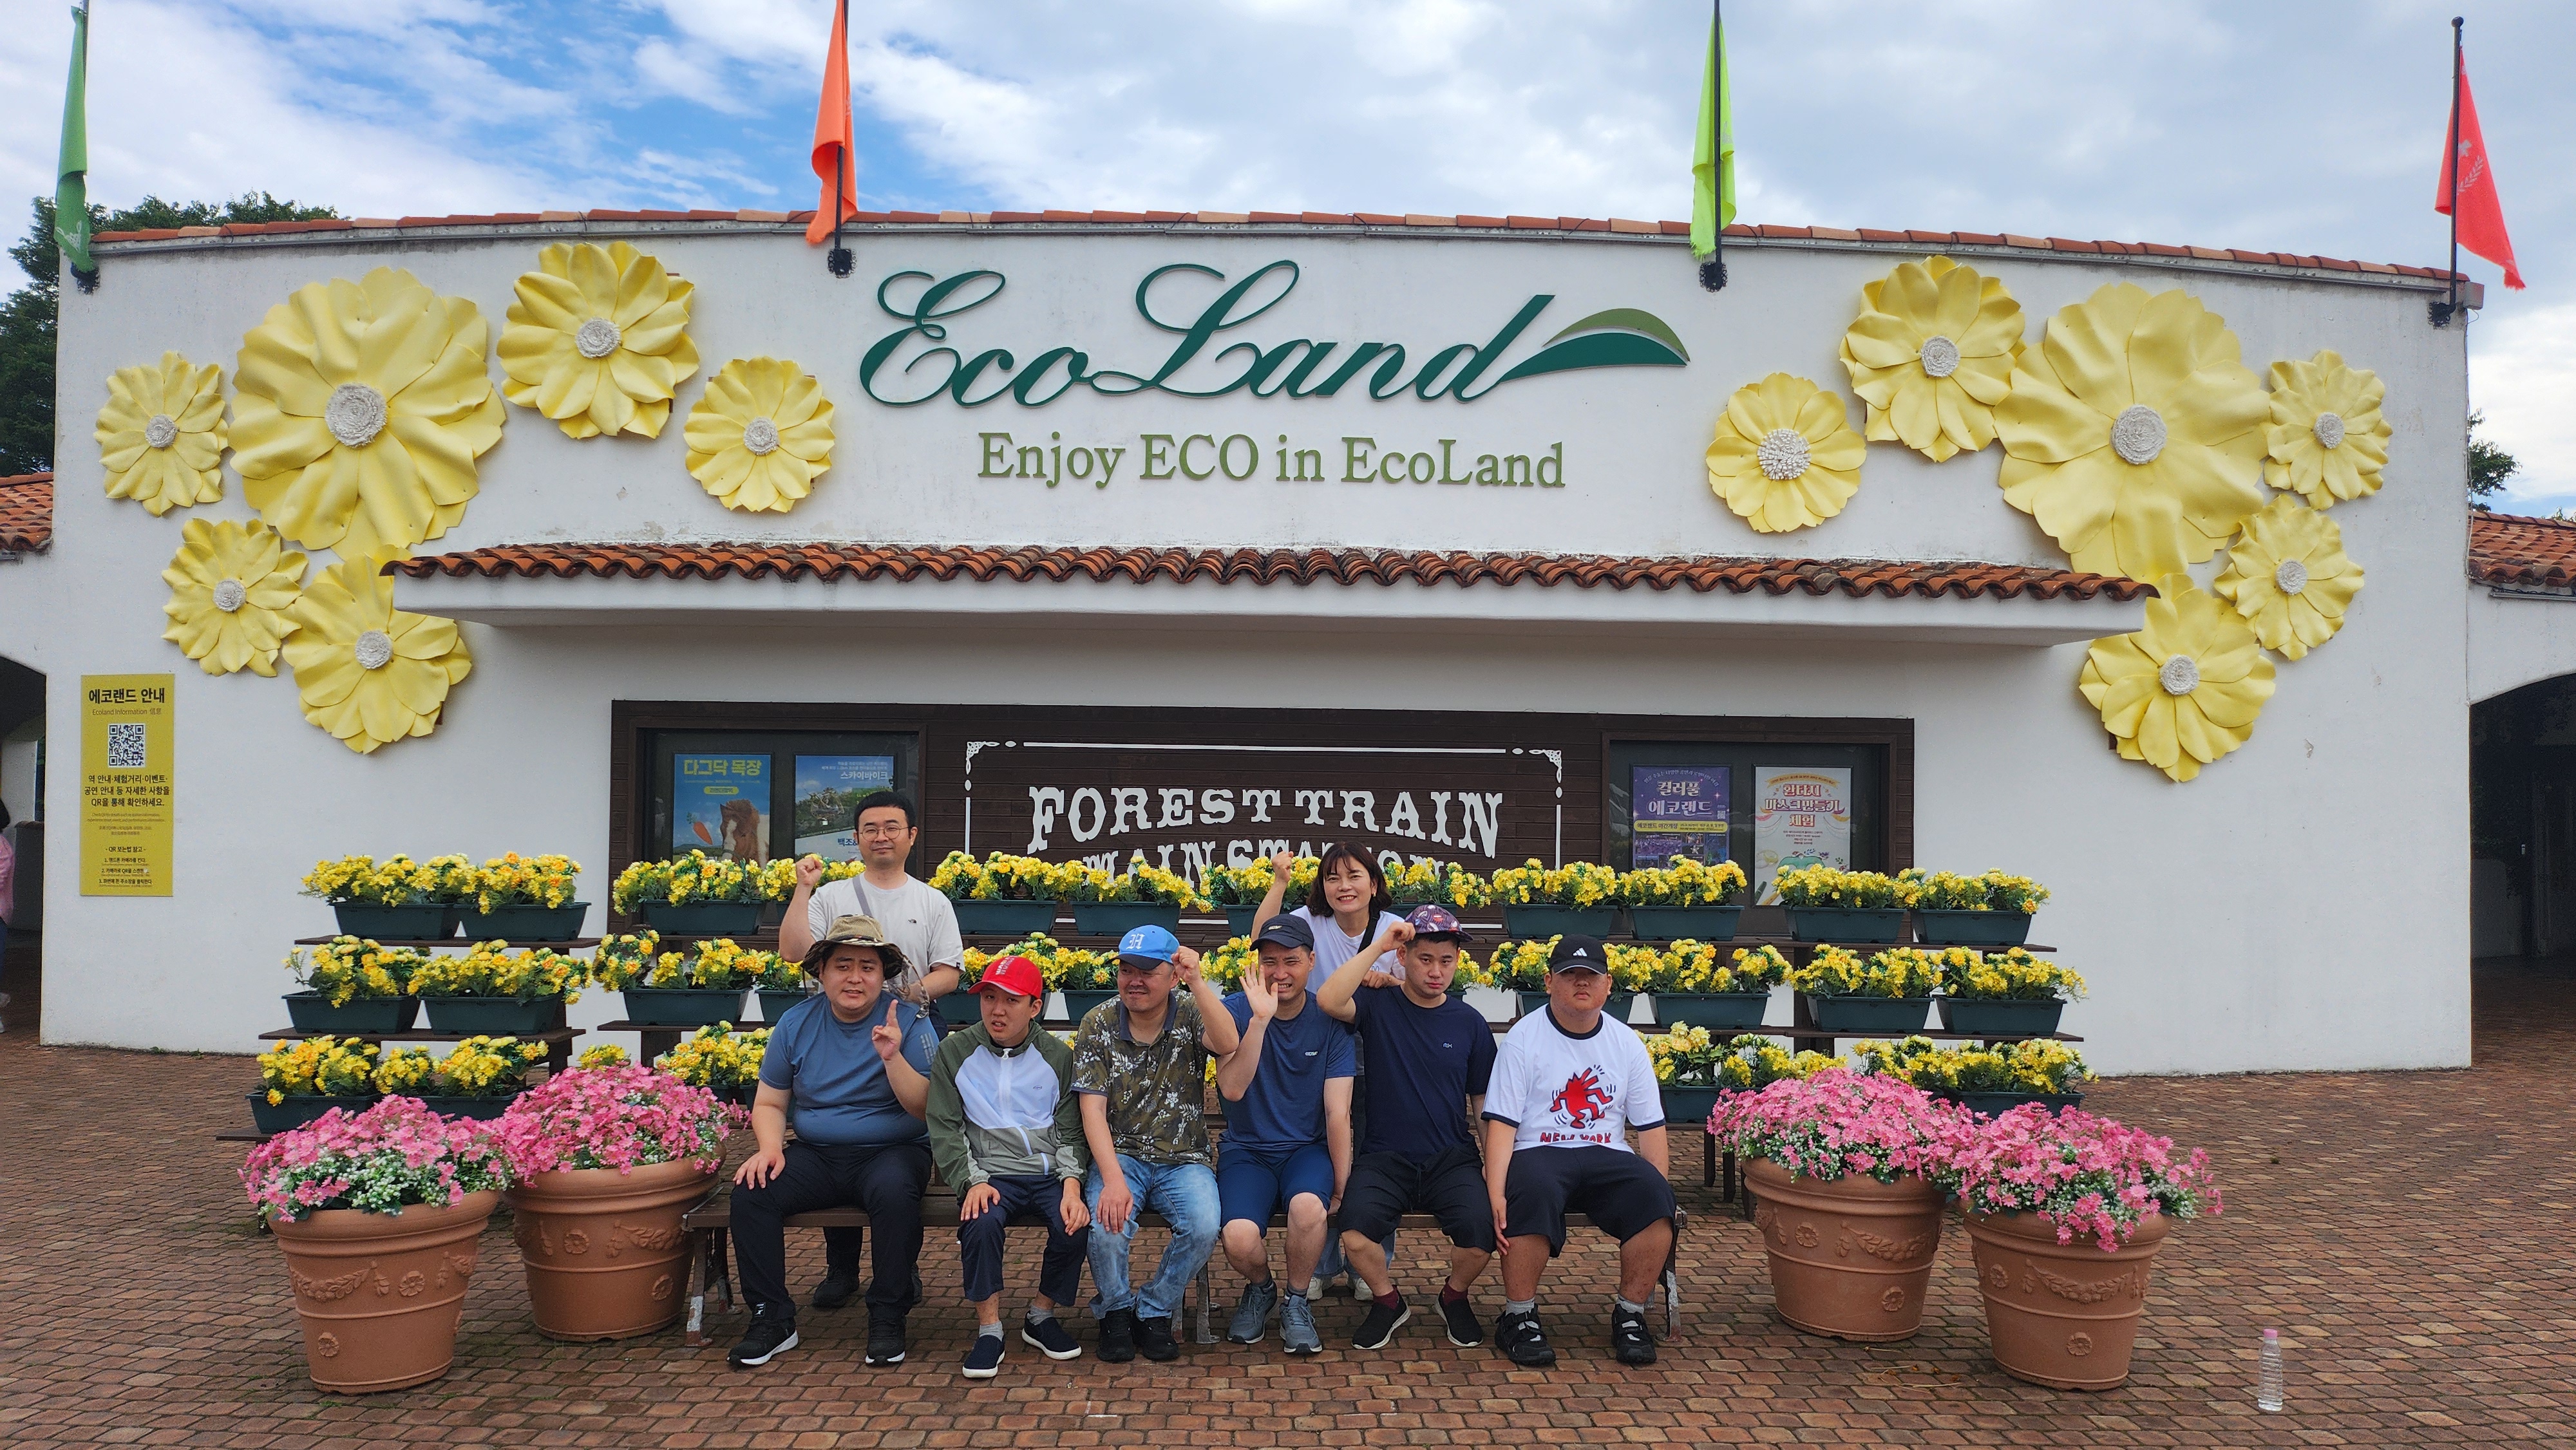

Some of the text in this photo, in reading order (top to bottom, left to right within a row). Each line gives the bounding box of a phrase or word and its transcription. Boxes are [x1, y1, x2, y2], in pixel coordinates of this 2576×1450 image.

[978, 431, 1566, 489] Enjoy ECO in EcoLand
[89, 688, 165, 704] 에코랜드 안내
[684, 759, 762, 777] 다그닥 목장
[840, 771, 889, 780] 스카이바이크
[88, 775, 95, 784] 역
[84, 786, 169, 795] 공연 안내 등 자세한 사항을
[1657, 781, 1700, 796] 컬러풀
[91, 798, 165, 807] QR을 통해 확인하세요.
[1648, 800, 1712, 816] 에코랜드
[1765, 799, 1840, 813] 마스크만들기
[1028, 787, 1503, 859] FOREST TRAIN
[1789, 814, 1815, 827] 체험
[1126, 933, 1145, 950] H
